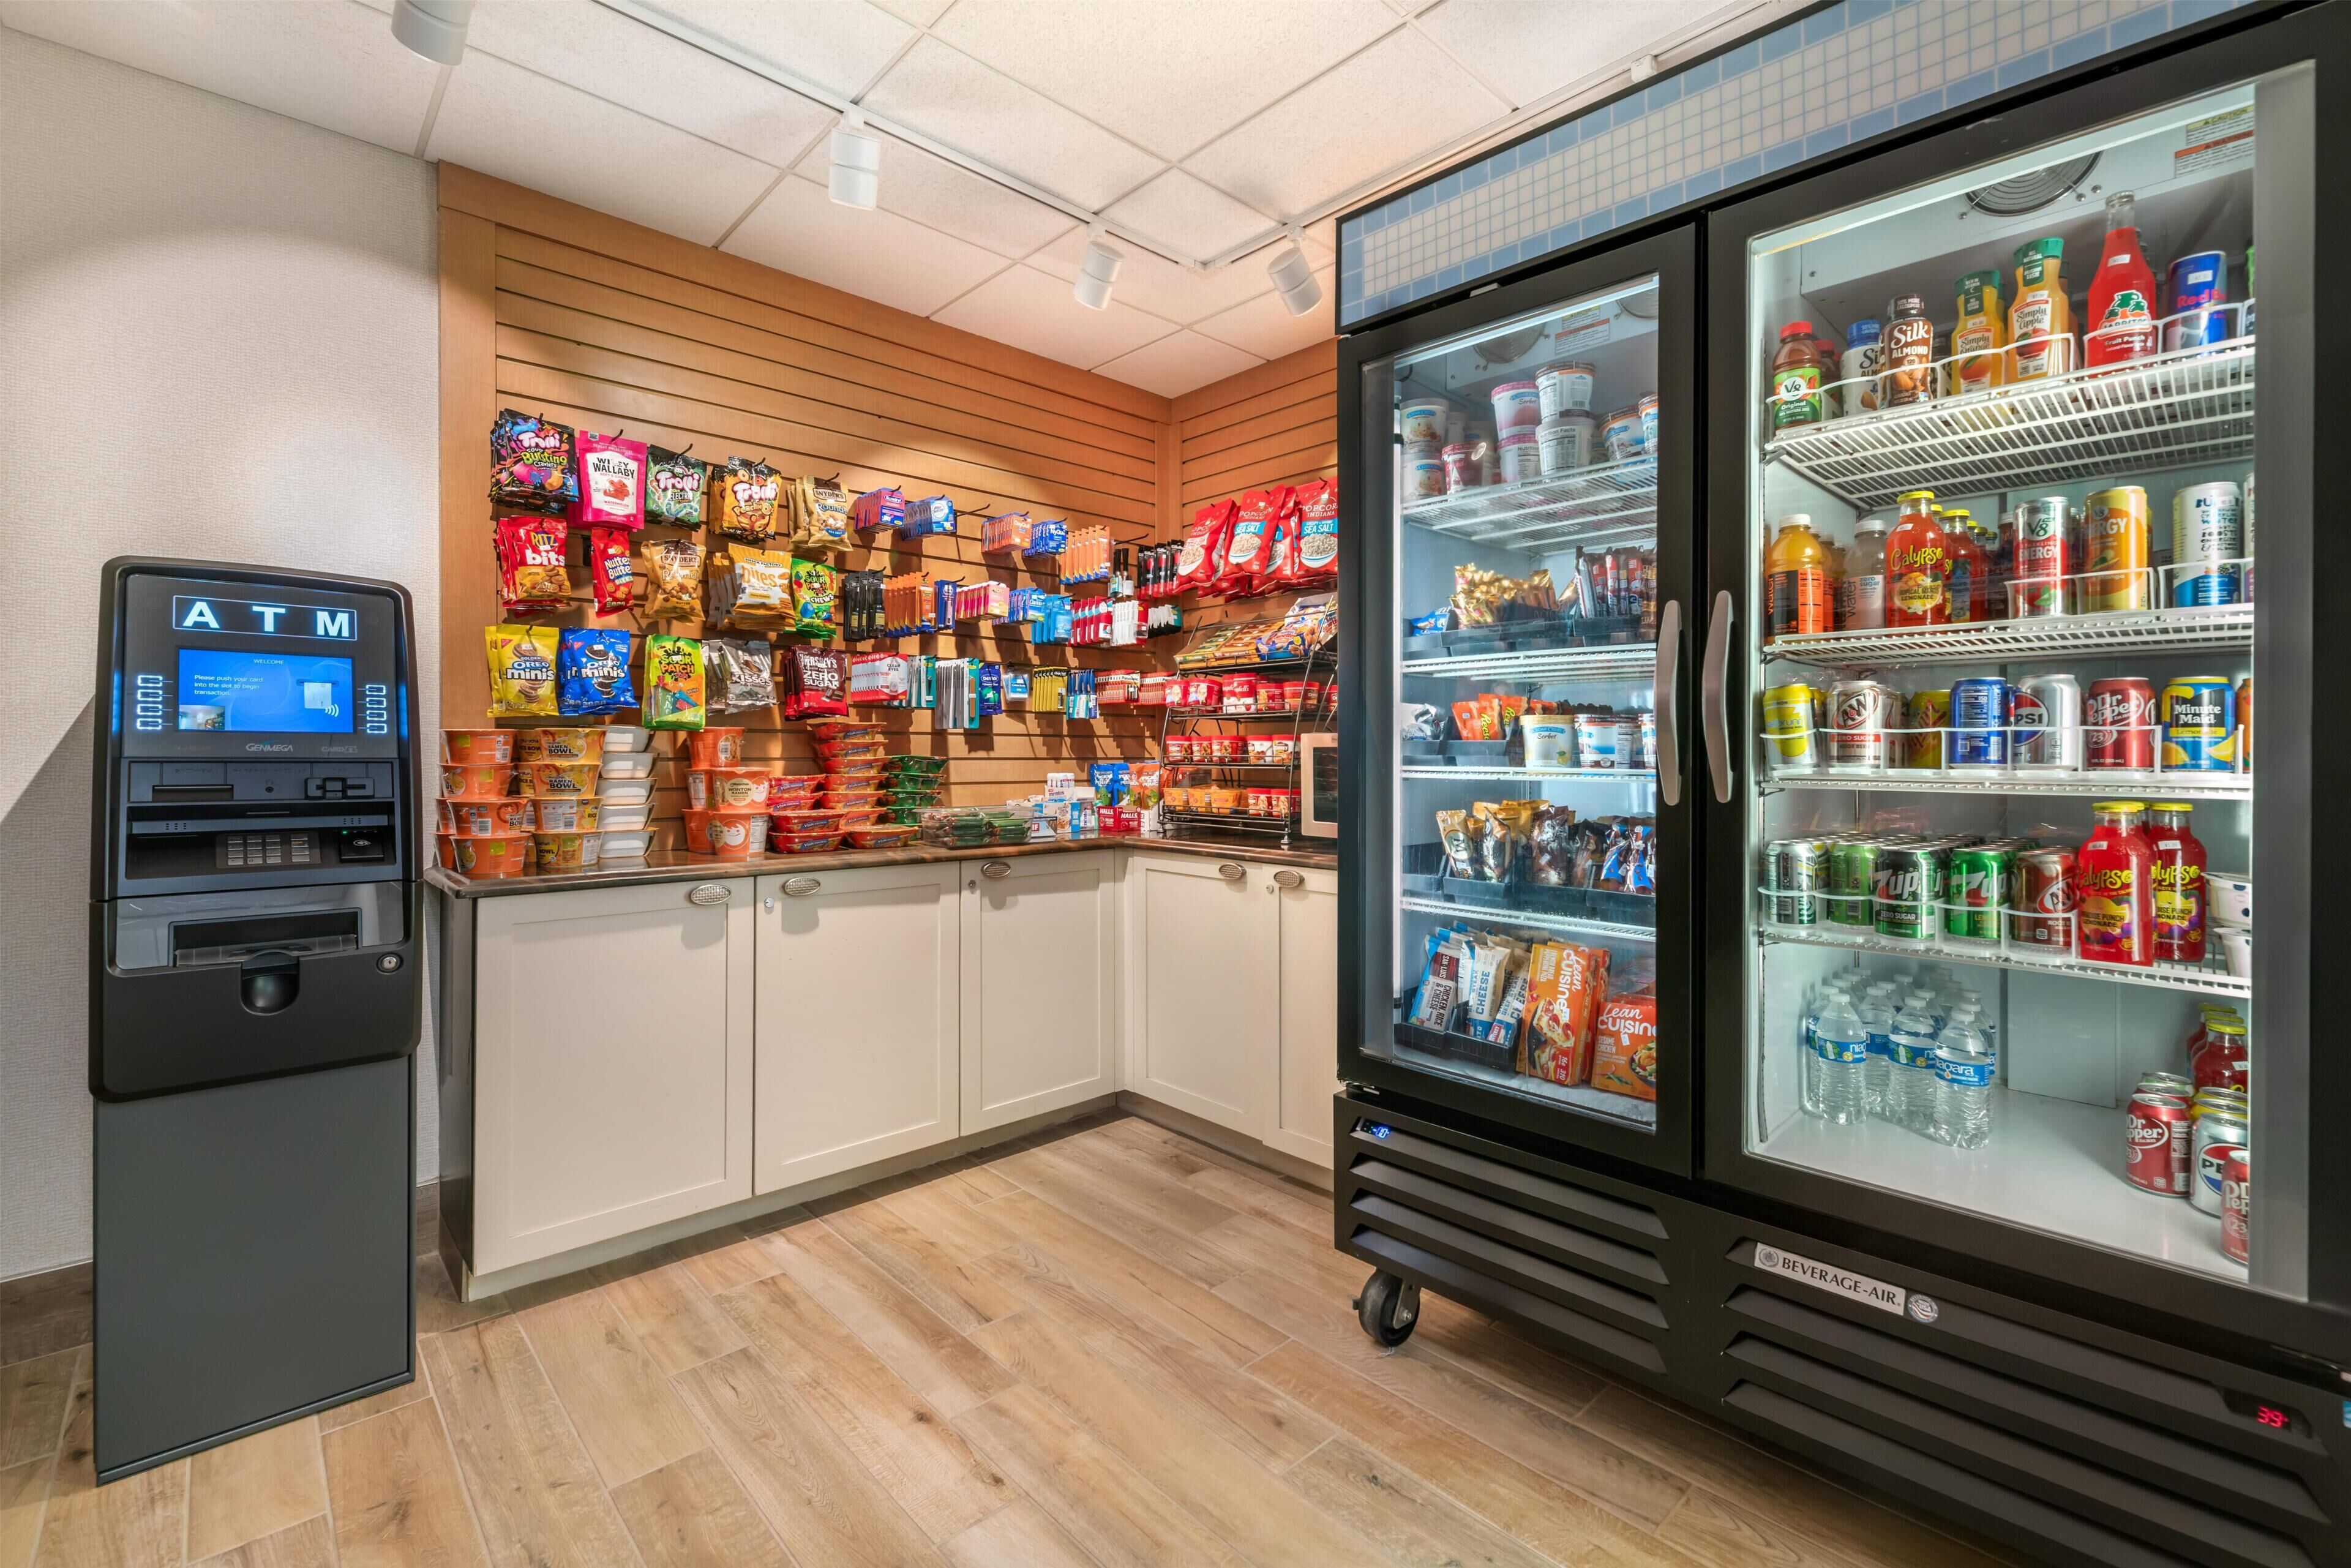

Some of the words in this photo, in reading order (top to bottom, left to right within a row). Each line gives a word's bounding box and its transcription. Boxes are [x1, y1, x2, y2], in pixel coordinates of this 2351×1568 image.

[2177, 289, 2210, 309] Red
[2016, 306, 2047, 322] Simply
[1890, 321, 1930, 349] Silk
[1960, 334, 1990, 348] Simply
[2105, 337, 2122, 346] Fruit
[1859, 348, 1879, 369] Si
[1892, 345, 1929, 359] ALMOND
[1780, 400, 1807, 410] Original
[520, 451, 568, 466] Bursting
[592, 462, 635, 479] WALLABY
[656, 471, 700, 490] Trolli
[815, 489, 844, 500] SNYDER'S
[817, 503, 848, 515] Rounds
[1302, 504, 1338, 512] POPCOR
[1236, 525, 1247, 533] SEA
[1247, 523, 1260, 532] SALT
[1303, 525, 1316, 534] SEA
[1319, 523, 1333, 532] SALT
[2027, 517, 2050, 537] V8
[530, 531, 557, 546] RITZ
[525, 549, 565, 567] bits
[1890, 544, 1944, 571] Calypso
[2019, 546, 2058, 561] ENERGY
[608, 566, 631, 579] Butte
[810, 593, 834, 604] CHEWS
[182, 601, 350, 638] ATM
[506, 667, 555, 680] minis
[581, 667, 626, 678] minis
[661, 664, 695, 673] PATCH
[803, 670, 839, 681] ZERO
[803, 679, 839, 689] SUGAR
[2097, 694, 2123, 708] Dr
[2174, 704, 2221, 715] Minute
[2016, 711, 2043, 725] PSI
[2179, 715, 2215, 724] Maid
[2091, 732, 2104, 742] 23
[246, 743, 293, 752] GENMEGA
[1894, 912, 1916, 921] SUGAR
[1572, 955, 1587, 992] Lean
[1475, 970, 1490, 1015] CHEESE
[1430, 989, 1442, 1011] CHEESE
[1602, 1003, 1644, 1019] Lean
[1434, 1010, 1445, 1027] RICE
[1598, 1035, 1615, 1046] SESAME
[1597, 1045, 1616, 1054] CHICKEN
[2128, 1115, 2146, 1129] Dr
